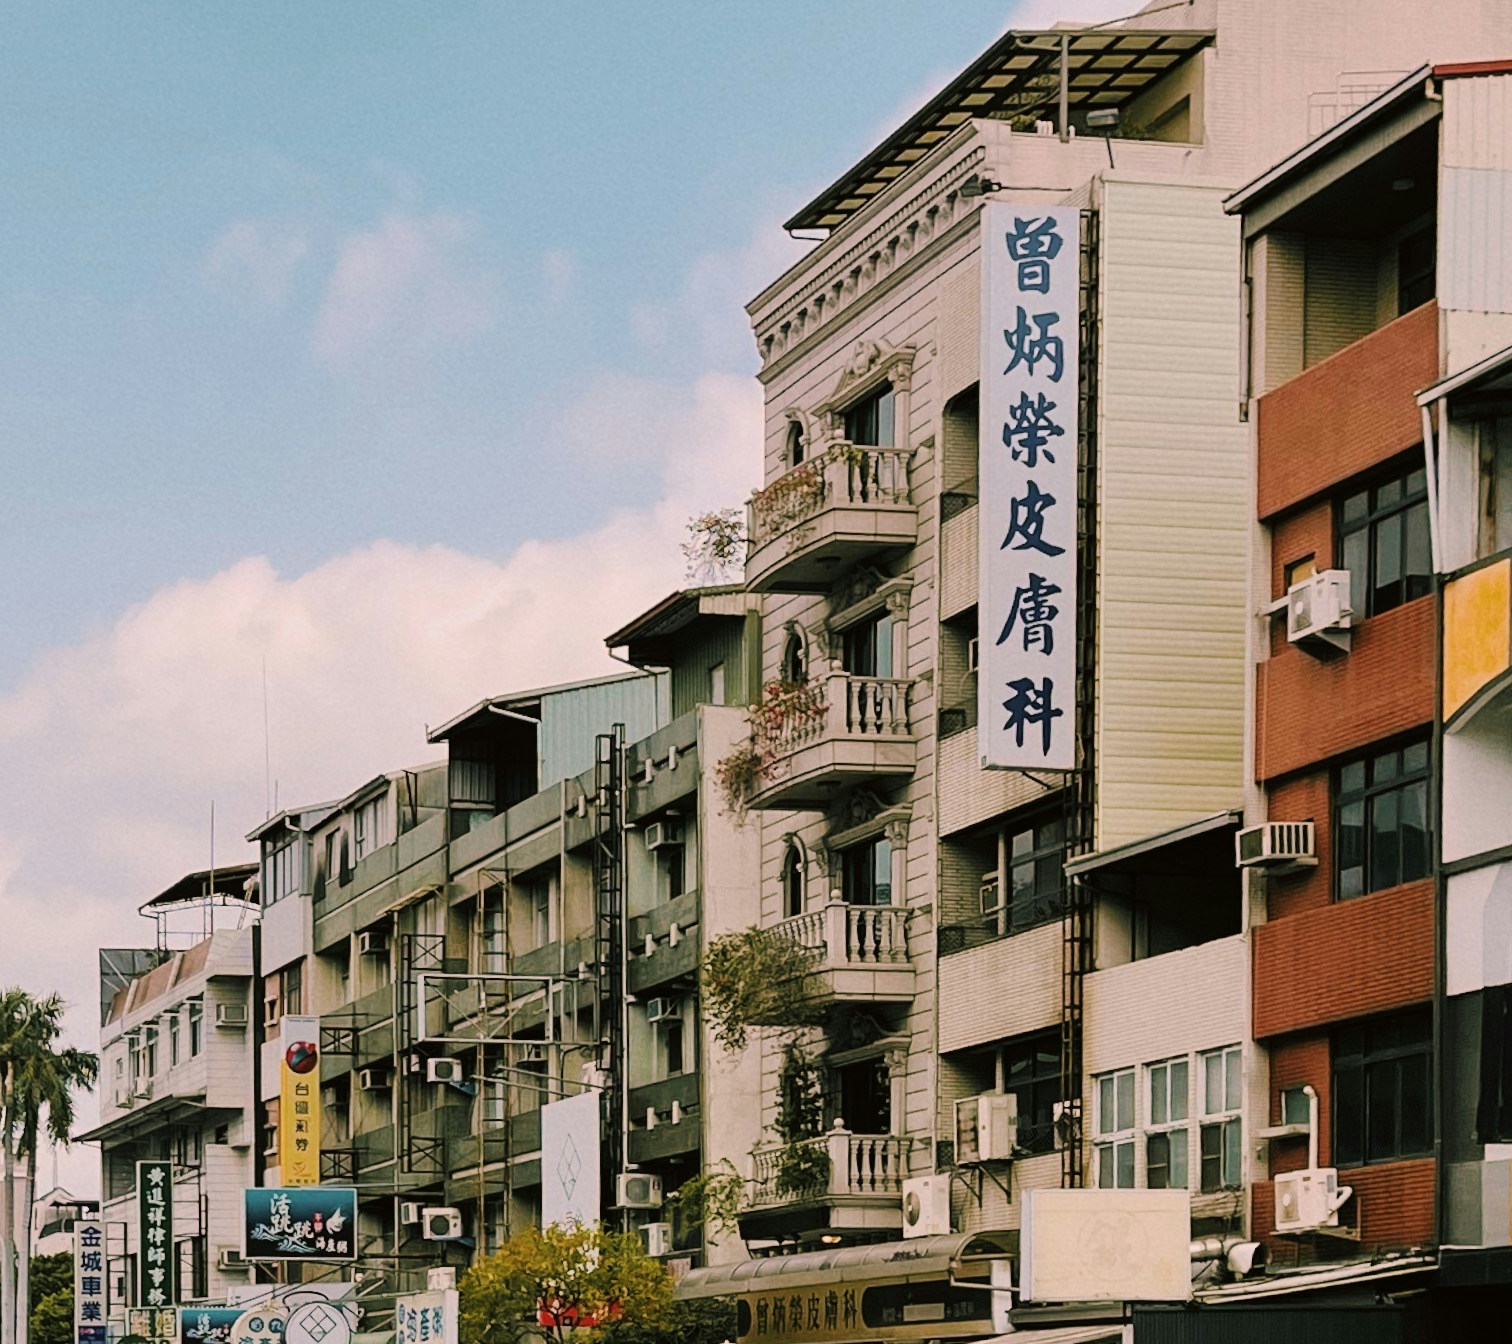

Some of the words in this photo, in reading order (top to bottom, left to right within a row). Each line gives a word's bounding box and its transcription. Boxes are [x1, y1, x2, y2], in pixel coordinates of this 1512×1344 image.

[997, 215, 1065, 758] 曾炳榮皮膚科
[80, 1225, 103, 1322] 金城車業
